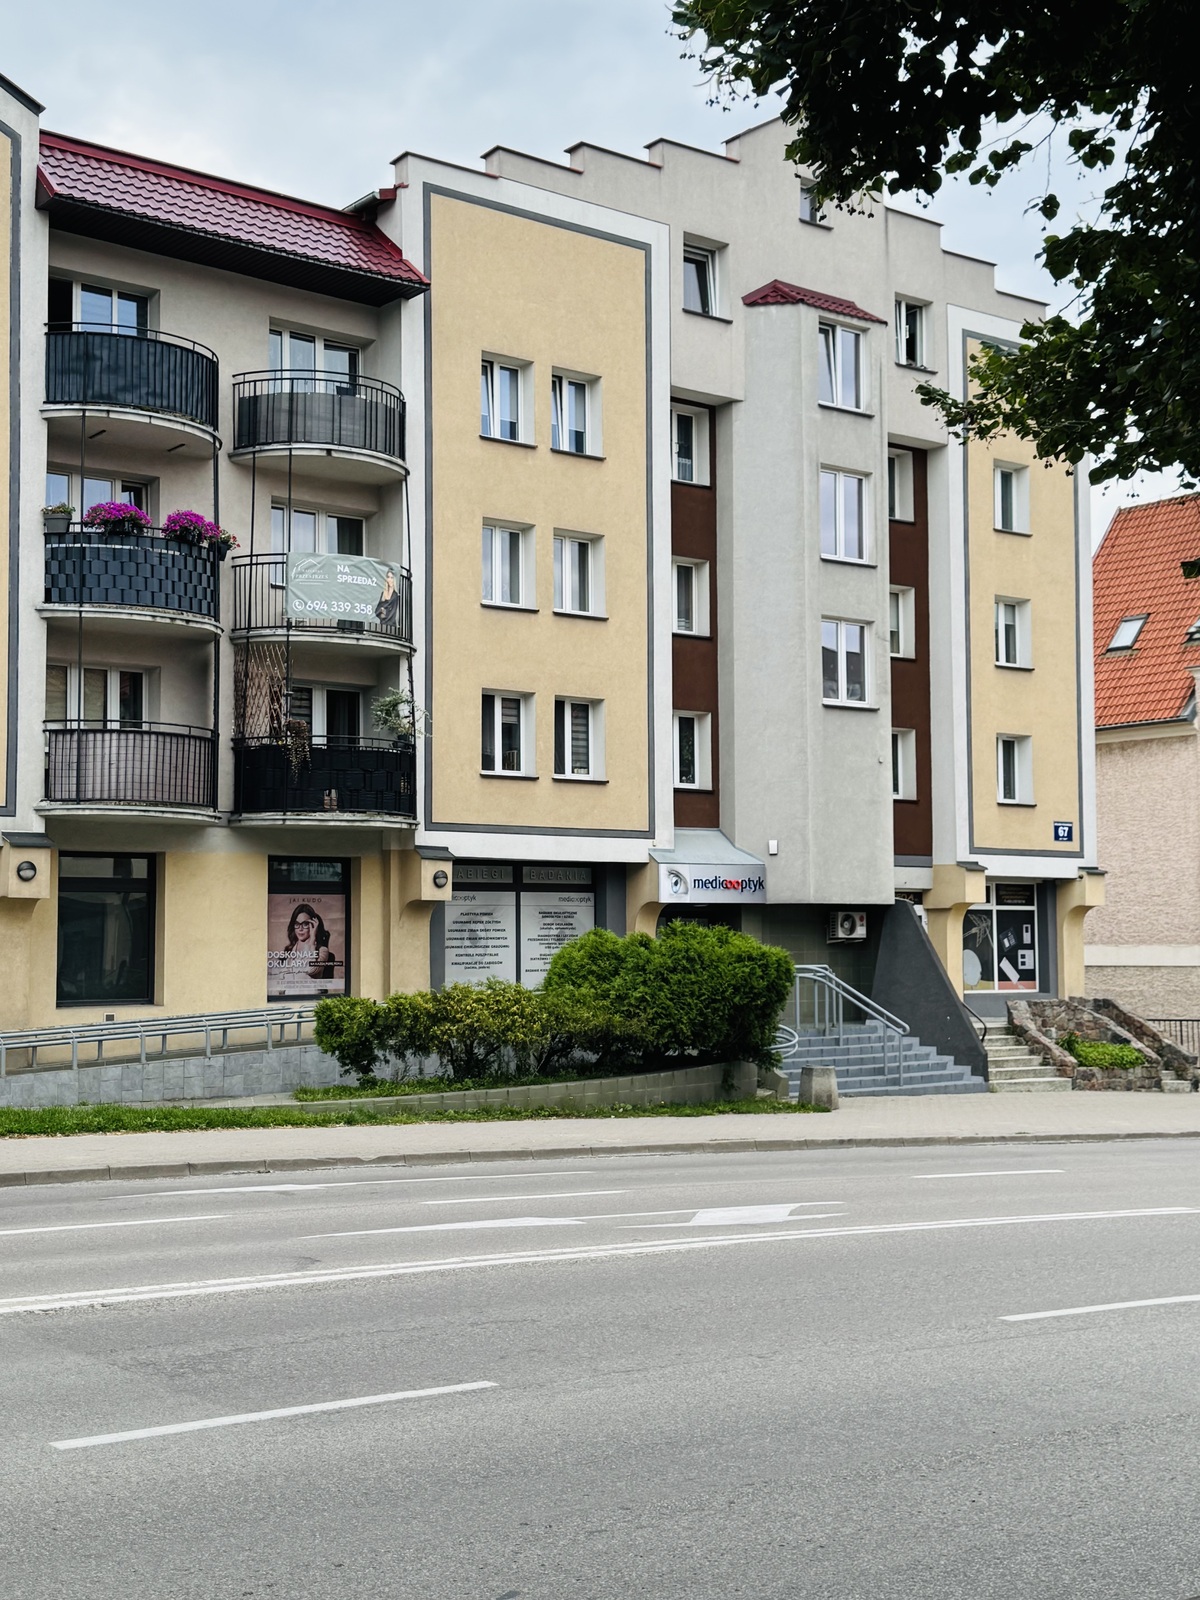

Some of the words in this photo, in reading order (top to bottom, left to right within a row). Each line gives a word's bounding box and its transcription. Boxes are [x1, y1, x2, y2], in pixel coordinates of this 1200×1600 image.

[337, 565, 350, 573] NA
[337, 574, 378, 587] SPRZEDAŻ
[306, 600, 328, 611] 694
[330, 601, 352, 612] 339
[353, 603, 373, 615] 358
[1058, 826, 1069, 837] 67
[457, 868, 504, 879] ABIEGI
[530, 869, 587, 880] BADANIA
[268, 950, 319, 959] DOSKONAŁE
[268, 960, 307, 968] OKULARY
